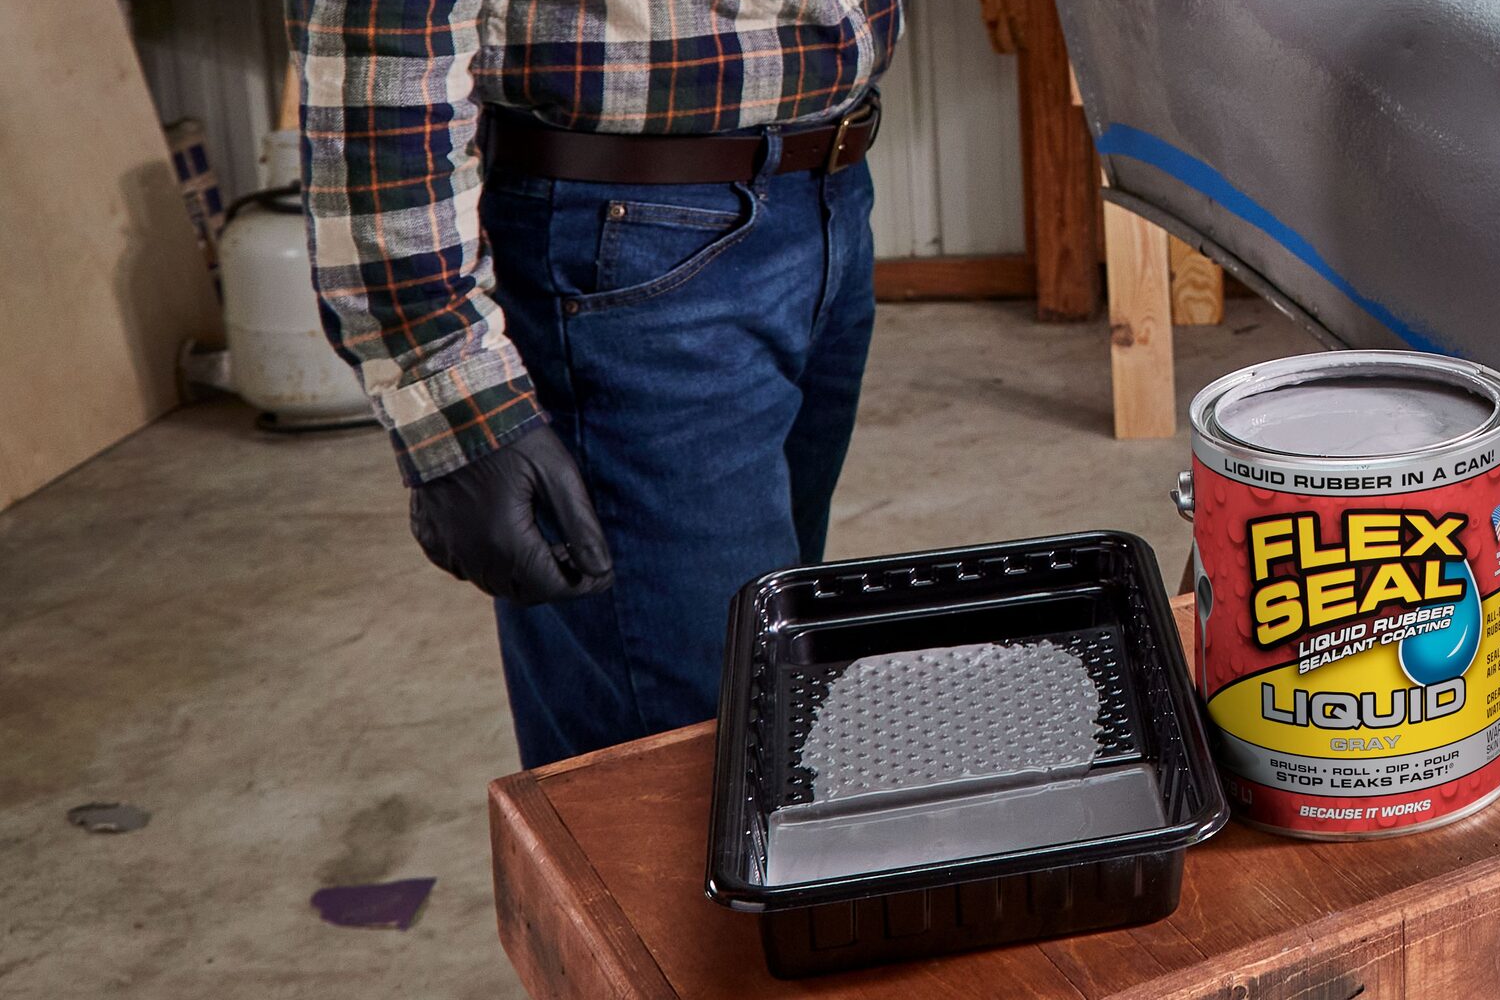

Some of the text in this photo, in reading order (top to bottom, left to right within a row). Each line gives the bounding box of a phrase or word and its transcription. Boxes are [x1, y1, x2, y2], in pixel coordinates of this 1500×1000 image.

[1224, 449, 1495, 490] LIQUID RUBBER IN A CAN!
[1250, 512, 1467, 582] FLEX
[1253, 558, 1465, 647] SEAL
[1299, 604, 1456, 659] LIQUID RUBBER
[1299, 617, 1452, 675] SEALANT COATING
[1486, 663, 1497, 679] AIR
[1261, 676, 1466, 730] LIQUID
[1270, 750, 1460, 776] BRUSH ROLL DIP POUR
[1330, 735, 1401, 751] GRAY
[1276, 771, 1323, 787] STOP
[1330, 775, 1393, 789] LEAKS
[1300, 799, 1432, 820] BECAUSE IT WORKS
